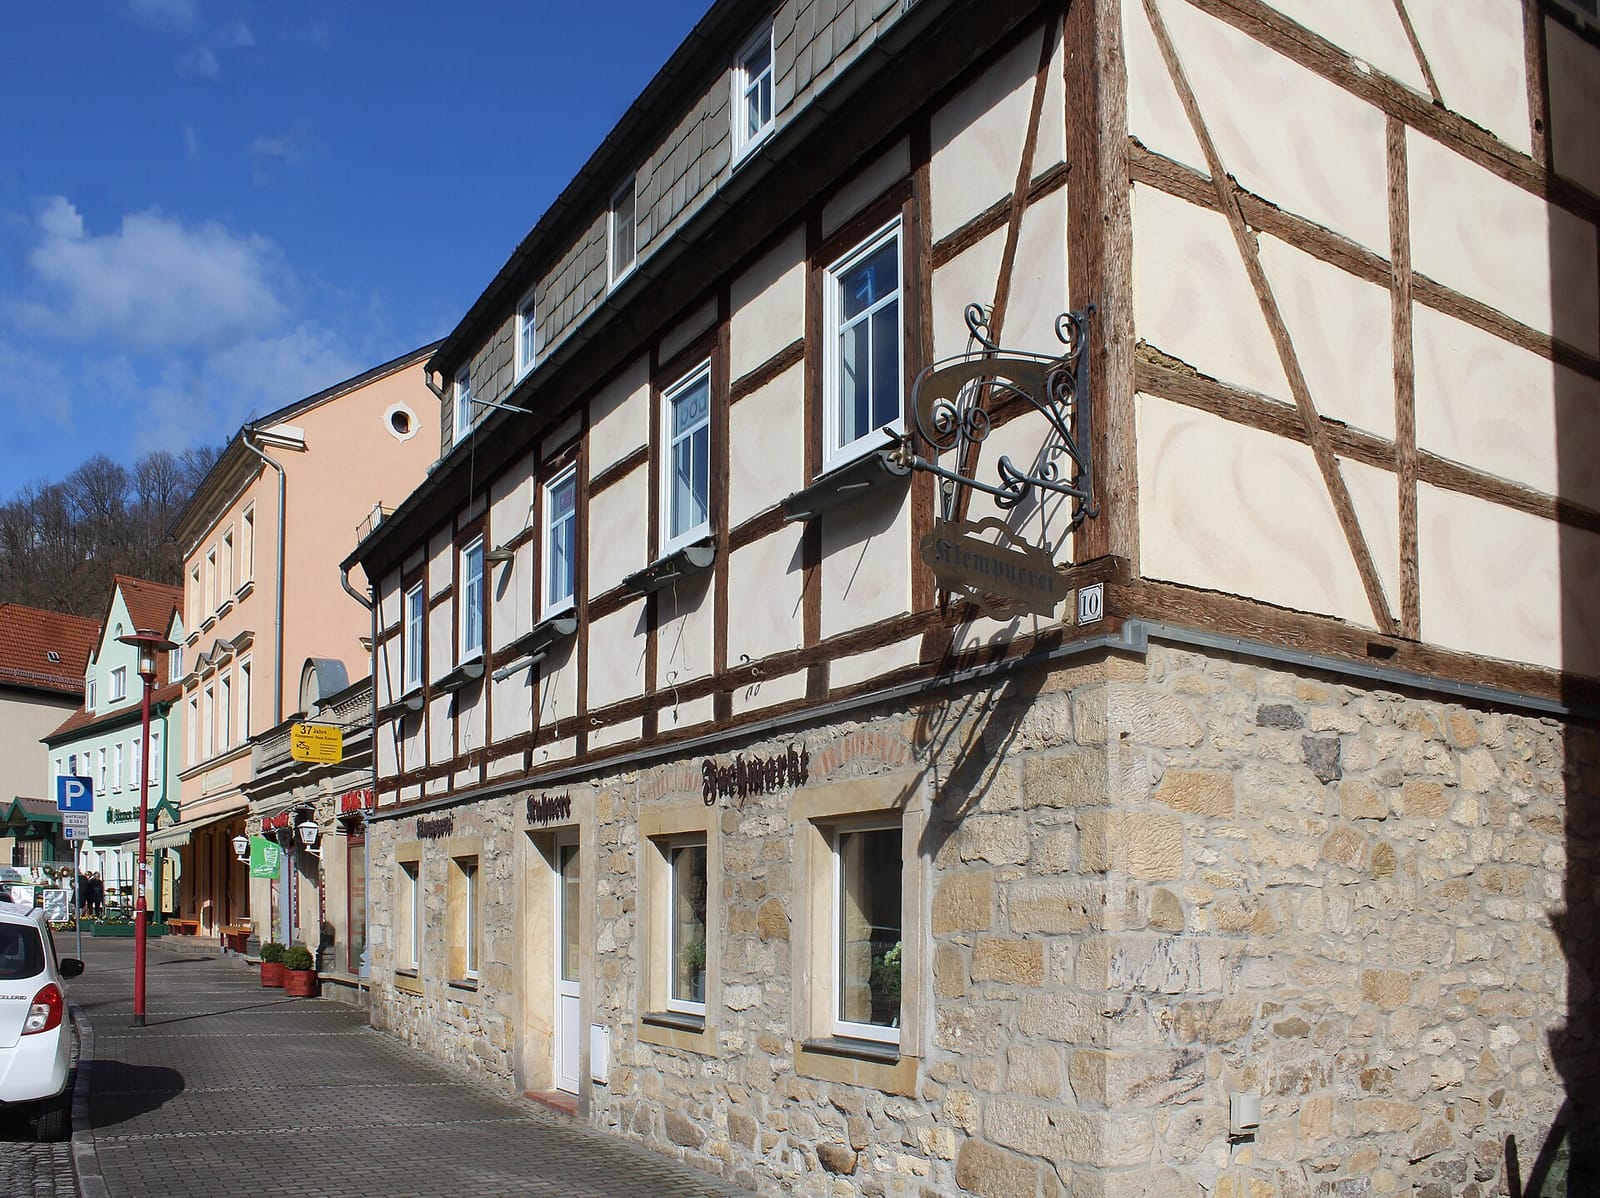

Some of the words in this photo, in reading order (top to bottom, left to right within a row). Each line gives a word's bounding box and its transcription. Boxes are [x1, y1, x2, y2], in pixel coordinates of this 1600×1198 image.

[1081, 592, 1099, 617] 10
[300, 725, 313, 735] 37
[702, 742, 810, 808] Fachmarkt
[65, 780, 85, 807] P
